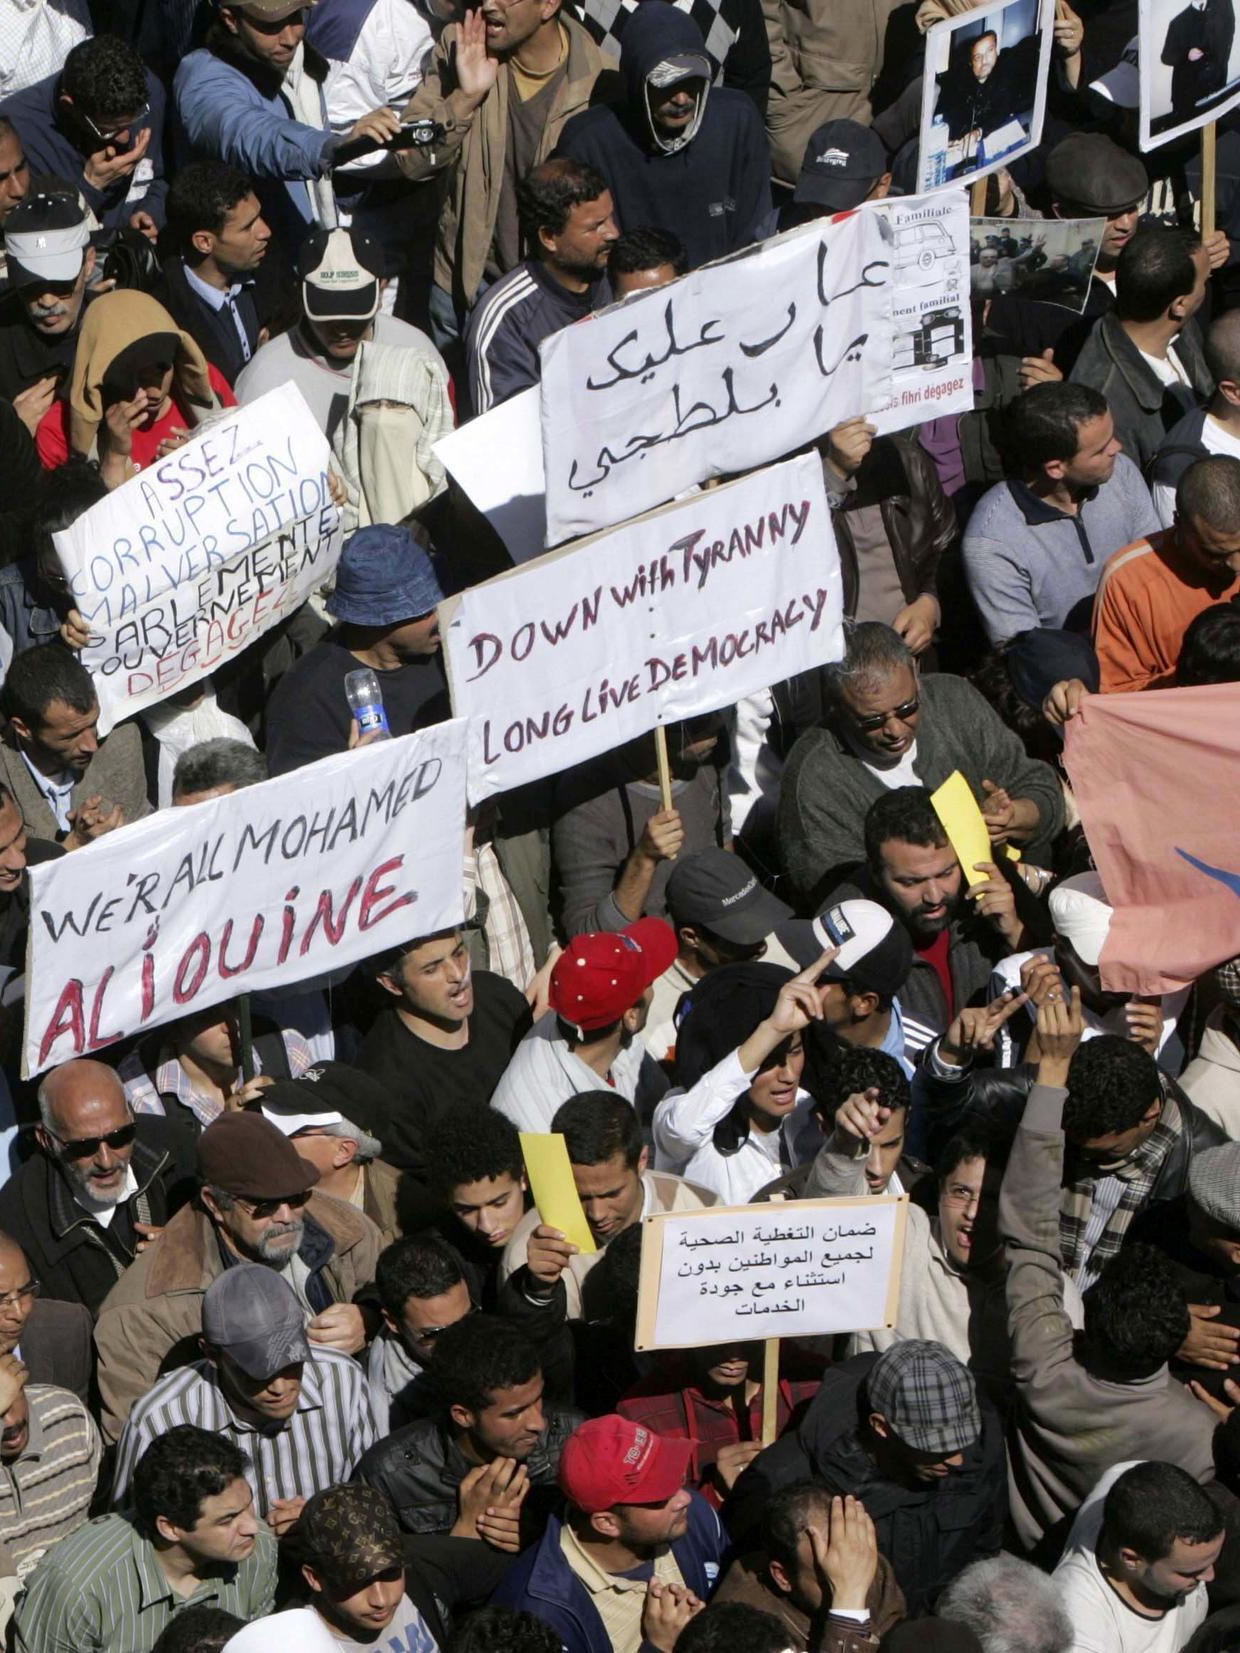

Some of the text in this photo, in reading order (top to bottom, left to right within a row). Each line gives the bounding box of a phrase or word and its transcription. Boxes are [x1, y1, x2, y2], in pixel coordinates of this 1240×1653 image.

[586, 239, 890, 391] عار عليك
[919, 293, 960, 311] familial
[140, 424, 250, 520] ASSEZ
[568, 366, 782, 499] بلطجي
[69, 436, 298, 597] CORRUPTION
[80, 470, 331, 627] MALVERSATION
[466, 586, 603, 683] DOWN
[483, 703, 575, 766] LONG
[644, 587, 828, 694] DEMOCRACY
[161, 832, 226, 910] ALL
[232, 758, 443, 873] MOHAMED
[677, 1246, 874, 1278] لجميع المواطنين بدون
[679, 1222, 877, 1251] ضمان التغطية الصحية
[699, 1271, 846, 1298] استثناء مع جودة
[735, 1299, 806, 1316] الخدمات
